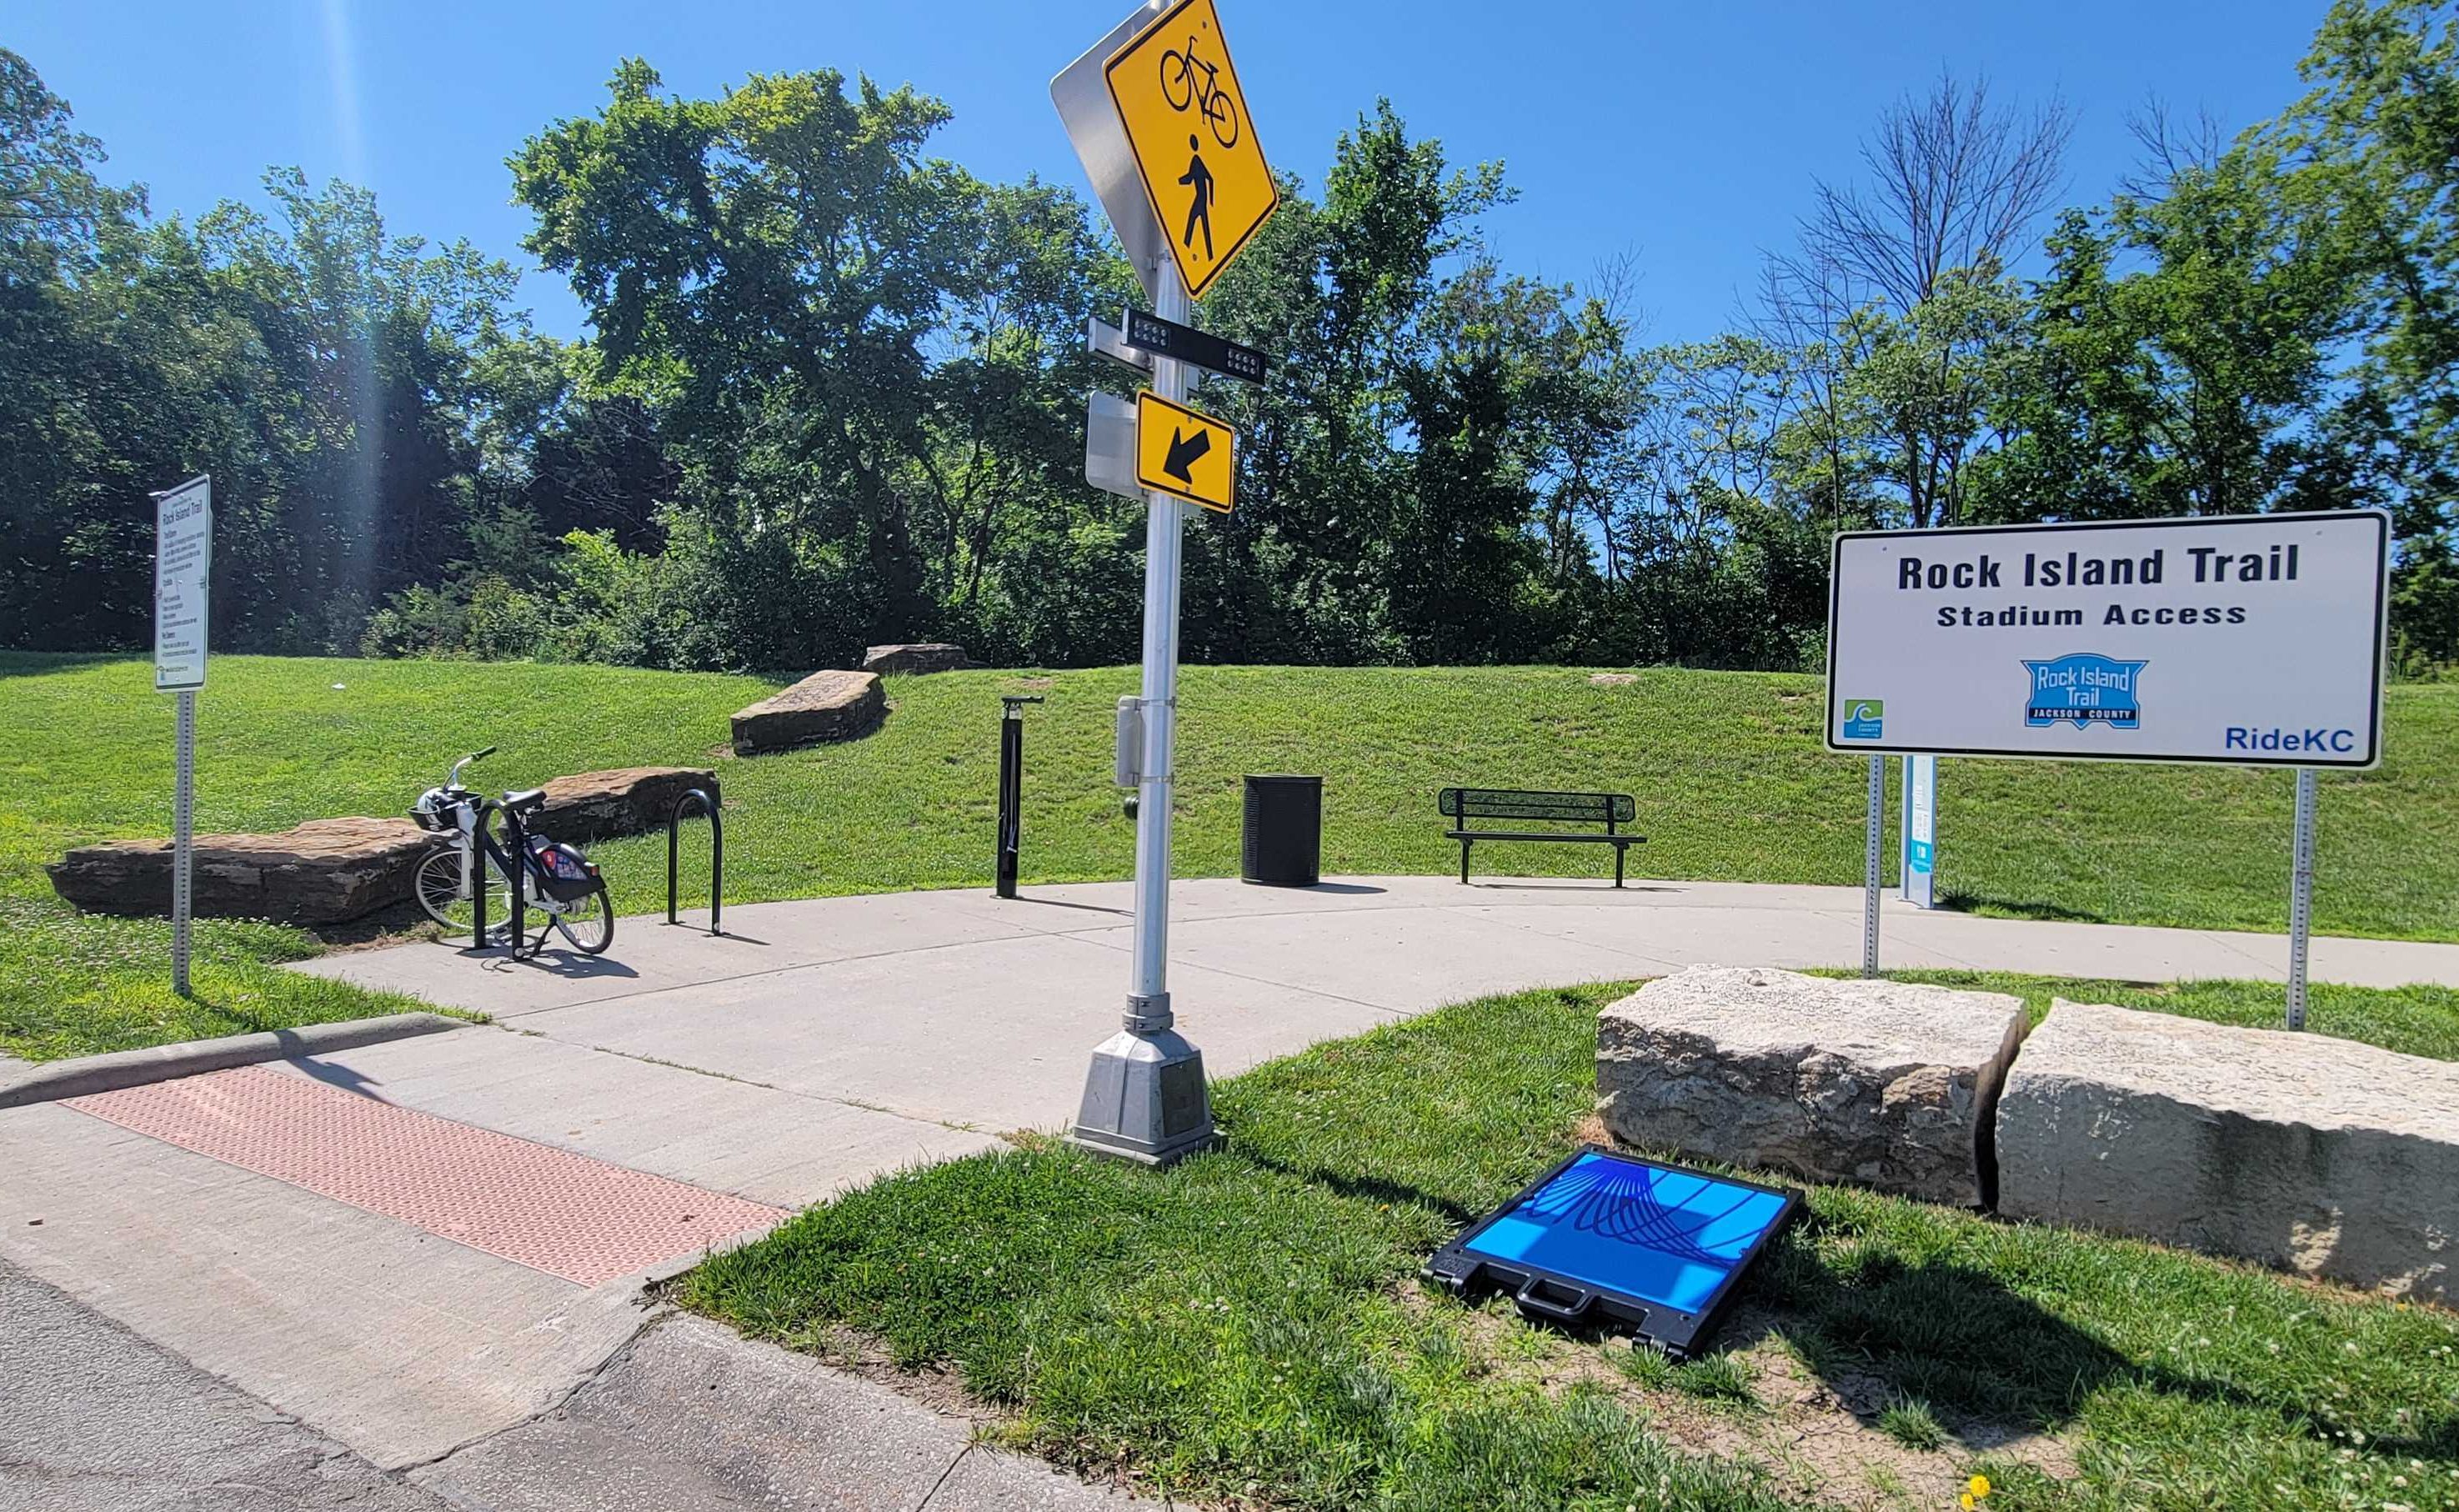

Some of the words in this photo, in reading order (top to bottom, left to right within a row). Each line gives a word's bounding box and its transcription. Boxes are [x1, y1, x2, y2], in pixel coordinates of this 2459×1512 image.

[1899, 554, 2001, 589] Rock
[2025, 549, 2163, 587] Island
[2187, 544, 2298, 583] Trail
[1937, 606, 2082, 627] Stadium
[2103, 604, 2246, 625] Access
[2038, 666, 2078, 690] Rock
[2081, 666, 2130, 692] Island
[2066, 686, 2100, 707] Trail
[2033, 709, 2081, 718] JACKSON
[2088, 709, 2131, 719] COUNTY
[2226, 728, 2355, 753] RideKC
